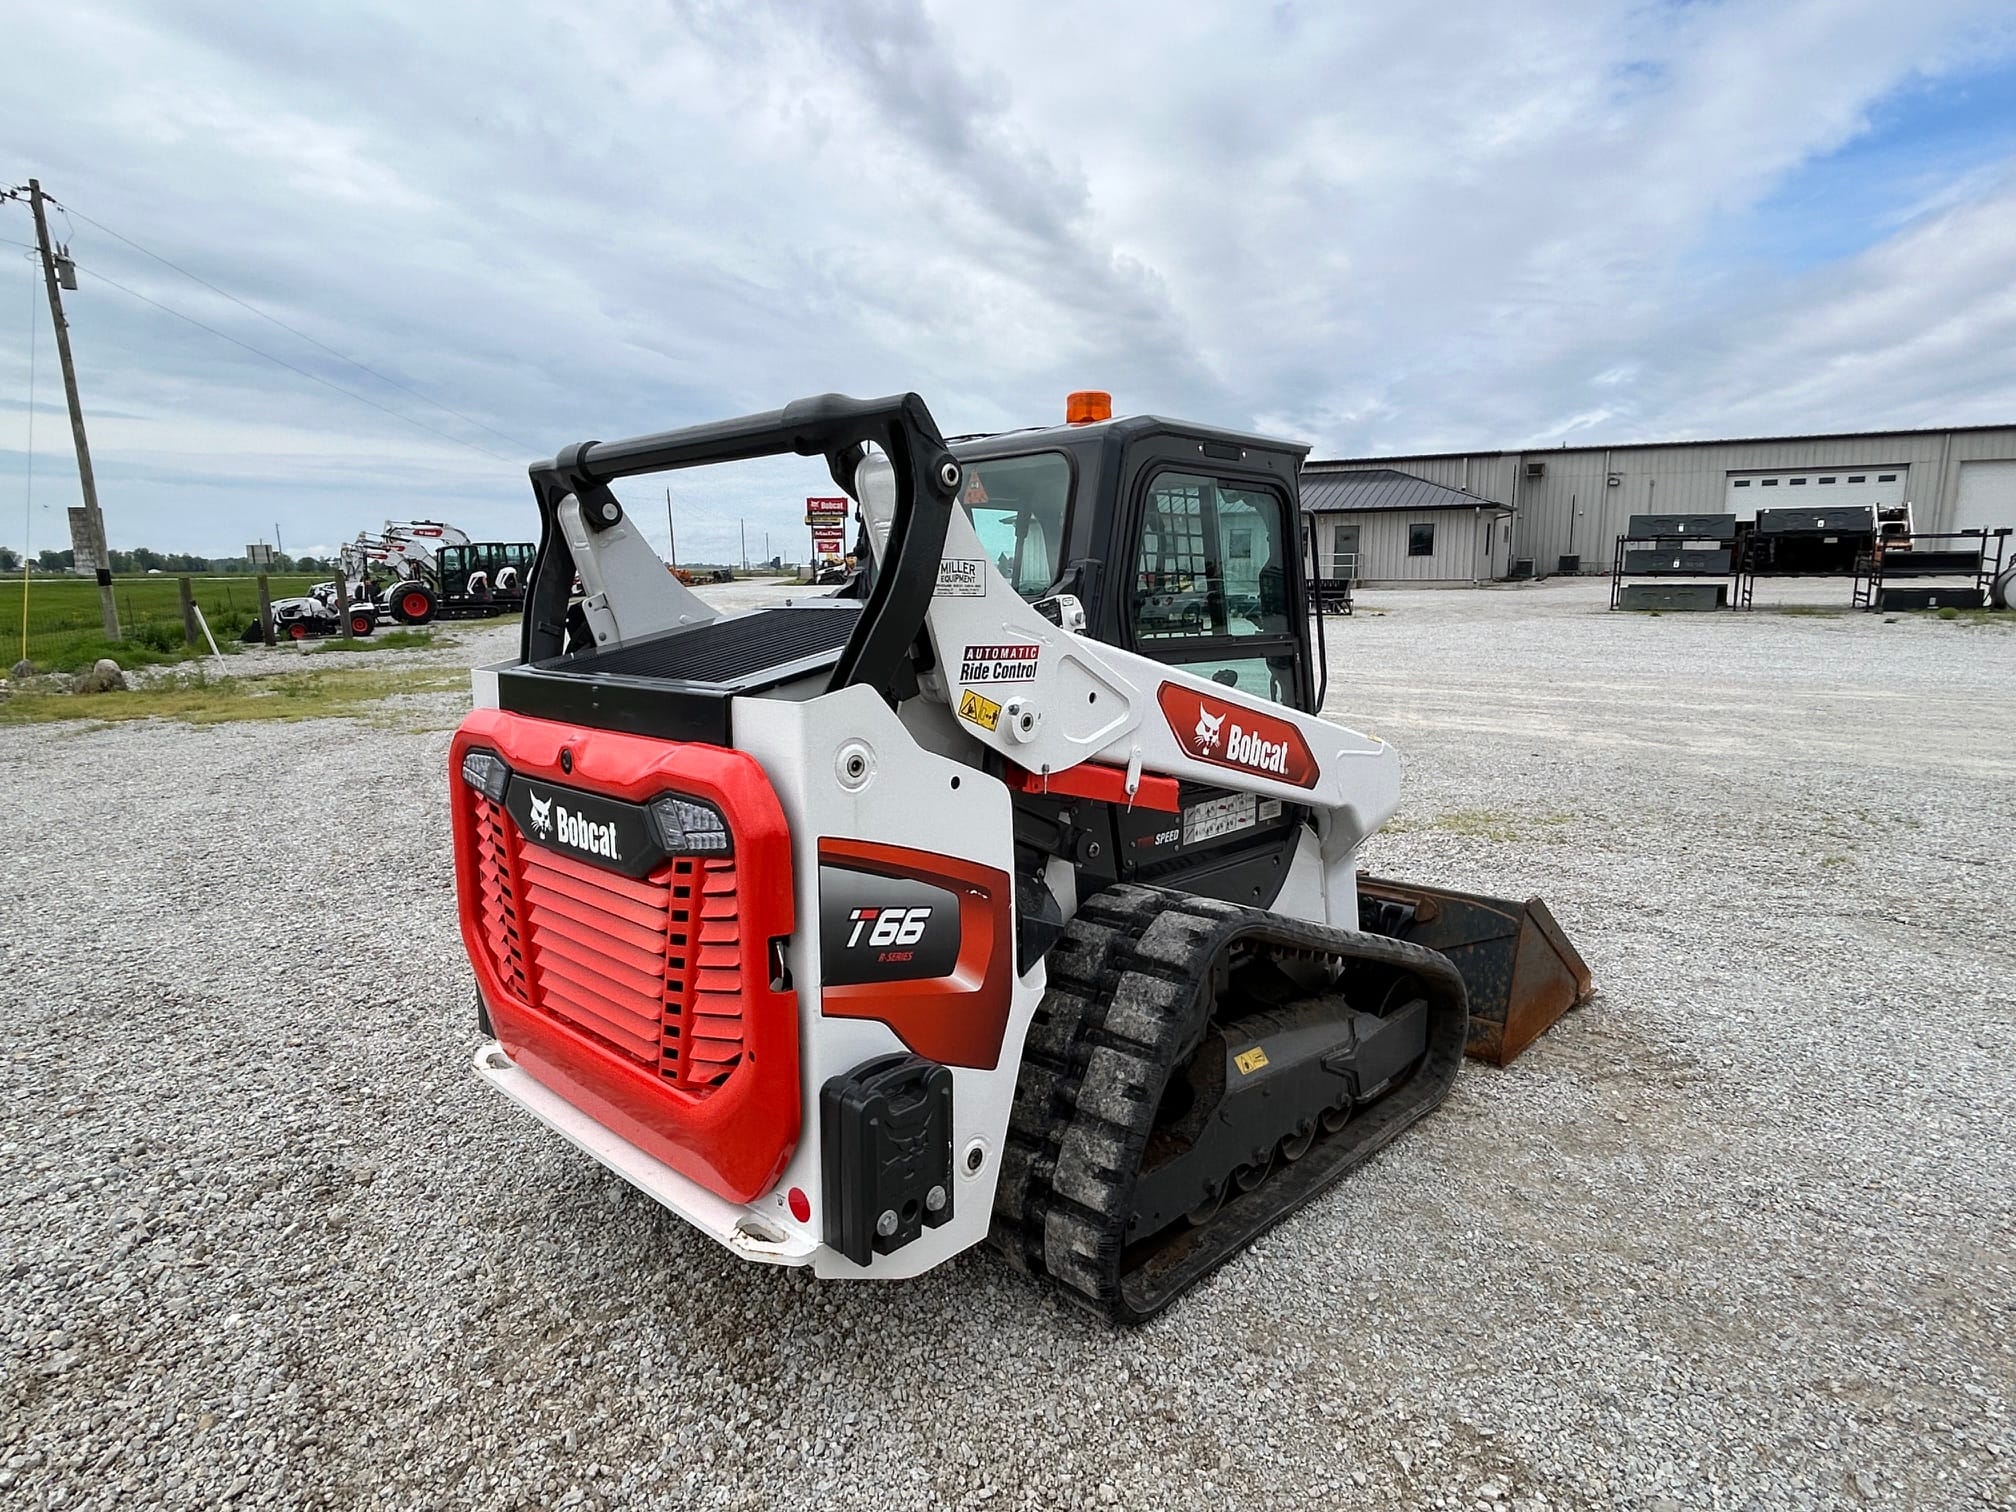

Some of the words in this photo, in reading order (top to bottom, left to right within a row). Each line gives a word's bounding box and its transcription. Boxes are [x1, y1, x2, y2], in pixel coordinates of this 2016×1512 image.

[941, 561, 976, 575] MILLER
[941, 574, 976, 583] EQUIPMENT
[966, 647, 1038, 660] AUTOMATIC
[960, 663, 990, 681] Ride
[993, 661, 1038, 680] Control
[1226, 724, 1288, 774] Bobcat
[556, 806, 619, 860] Bobcat
[1154, 829, 1180, 845] SPEED
[846, 908, 932, 948] T66
[878, 951, 914, 962] R-SERIES
